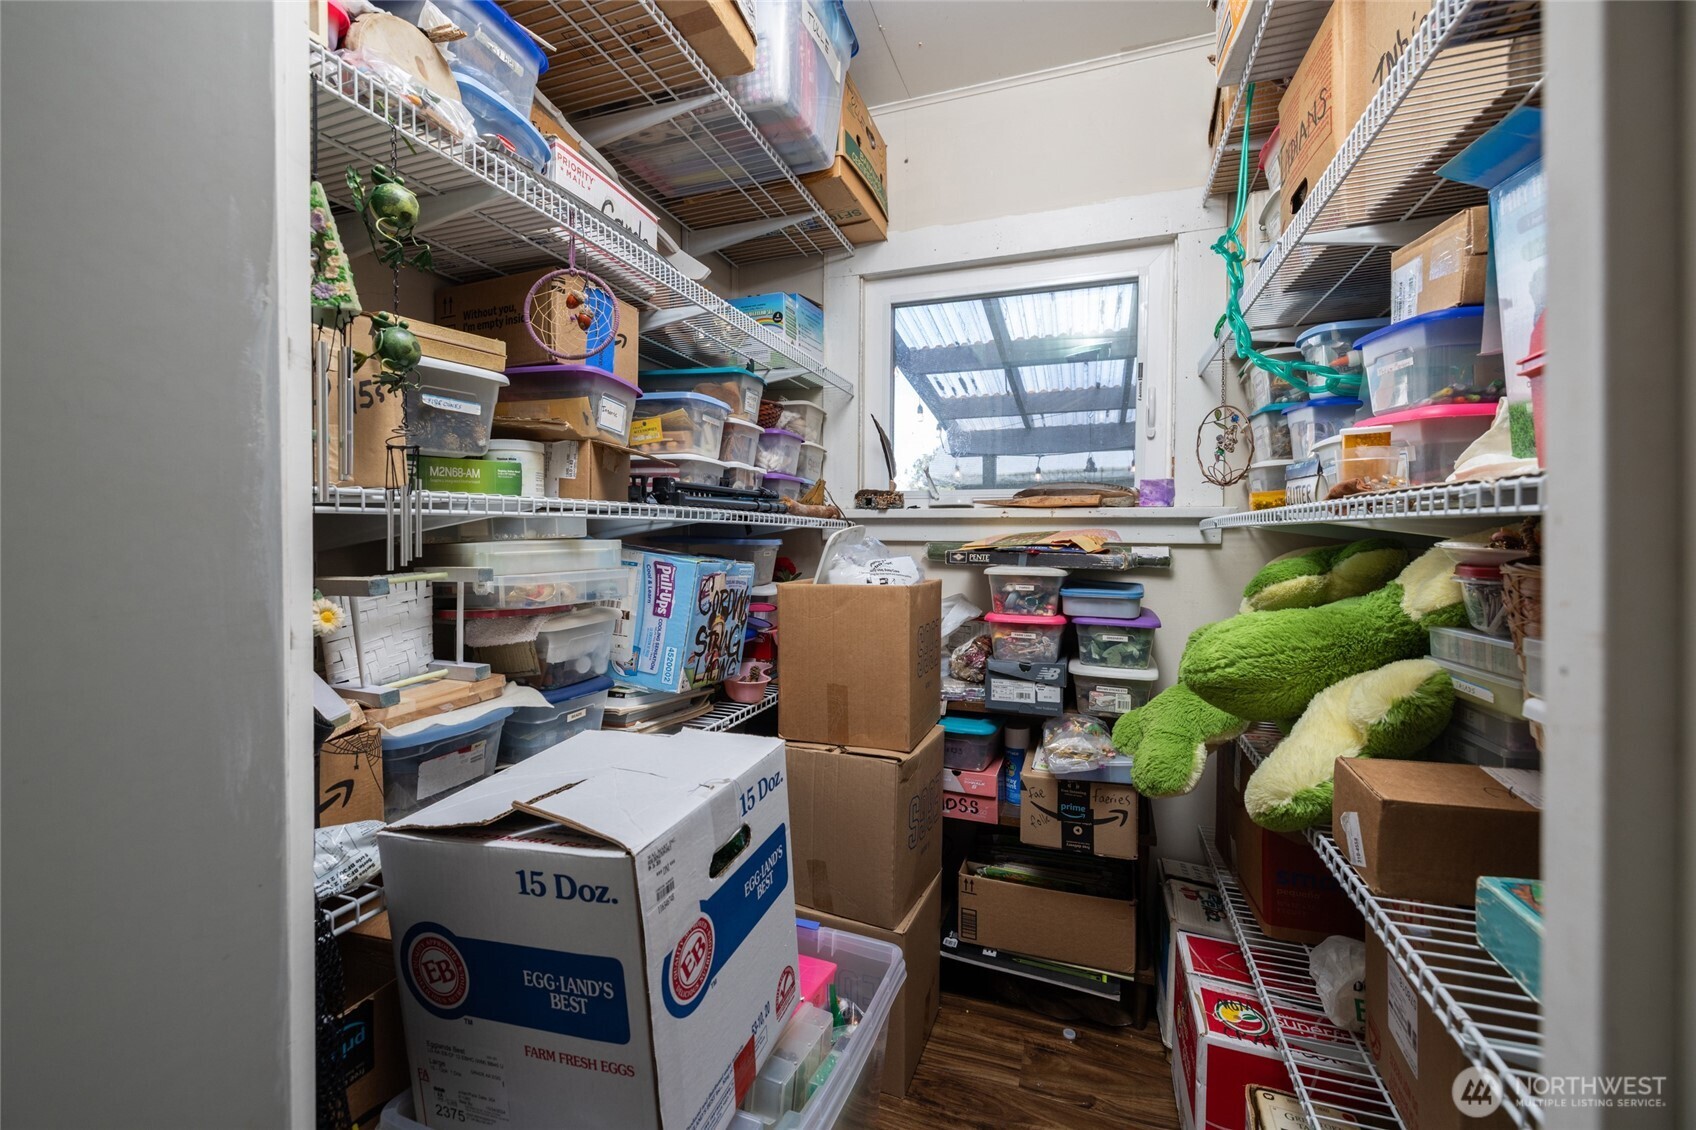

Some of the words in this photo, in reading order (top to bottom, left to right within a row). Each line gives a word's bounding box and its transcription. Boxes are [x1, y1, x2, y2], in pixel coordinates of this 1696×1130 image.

[557, 152, 594, 185] PRIORITY
[566, 169, 586, 189] MAIL
[463, 306, 497, 321] Without
[499, 303, 517, 315] you,
[477, 317, 505, 332] empty
[429, 466, 480, 479] M2N68-AM
[969, 553, 991, 563] PENTE
[655, 618, 664, 640] COOLING
[650, 640, 661, 671] SENSATION
[664, 647, 676, 684] 4520002
[740, 786, 756, 818] 15
[757, 771, 784, 802] Doz.
[1061, 803, 1086, 813] prime
[516, 869, 547, 898] 15
[553, 873, 618, 904] Doz.
[757, 870, 774, 901] BEST
[681, 936, 707, 982] EB
[421, 959, 456, 984] EB
[550, 992, 588, 1014] BEST
[524, 1045, 556, 1062] FARM
[559, 1052, 597, 1071] FRESH
[601, 1060, 635, 1078] EGGS
[435, 1103, 466, 1123] 2375
